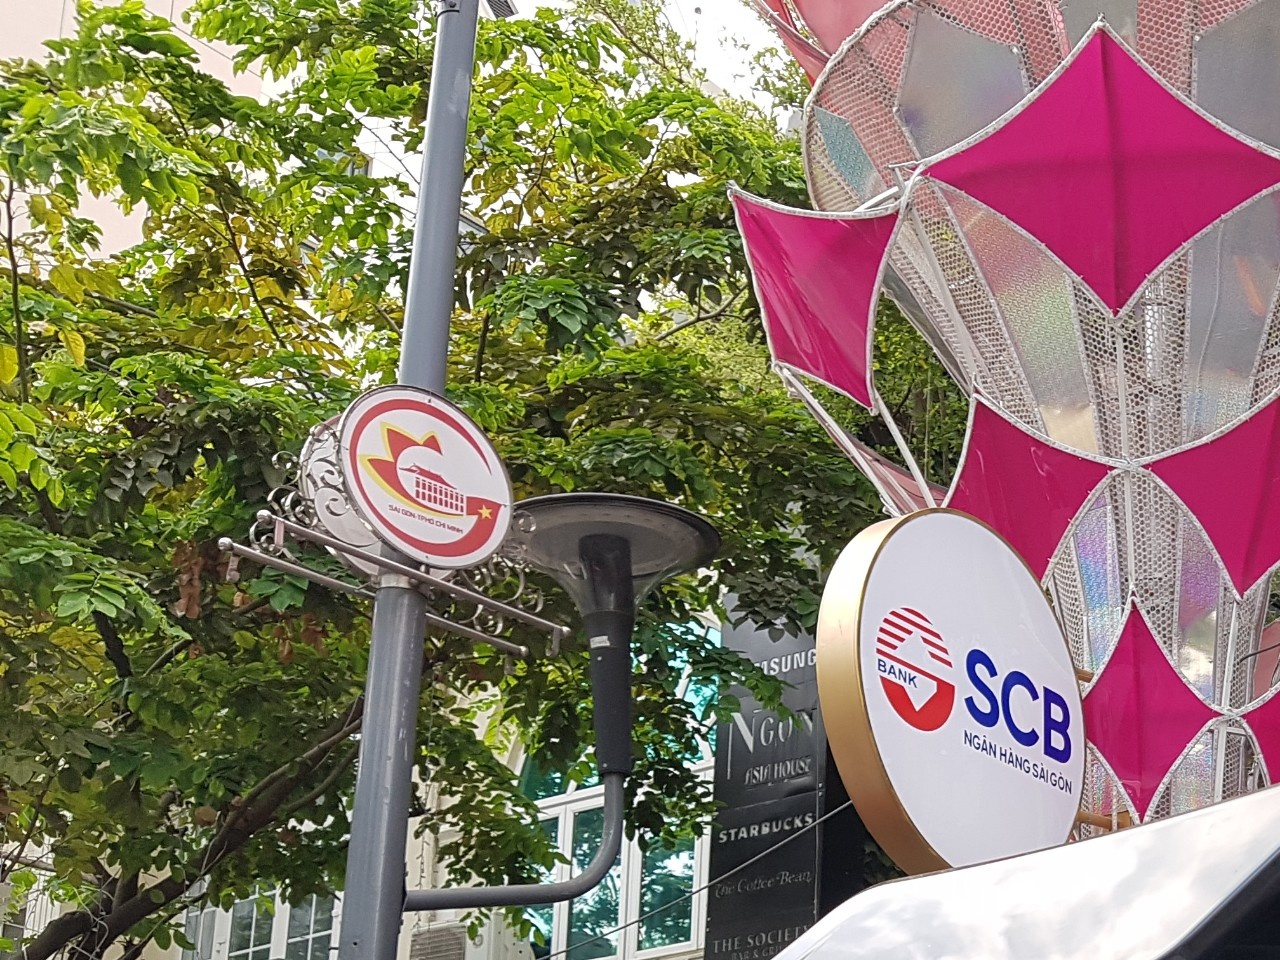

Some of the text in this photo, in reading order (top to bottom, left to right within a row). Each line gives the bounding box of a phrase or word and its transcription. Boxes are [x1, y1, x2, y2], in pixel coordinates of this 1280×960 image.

[877, 658, 918, 689] BANK
[964, 648, 1072, 764] SCB
[964, 729, 1073, 795] NGÂN HÀNG SÀI GÒN
[718, 813, 813, 843] STARBUCKS
[712, 936, 741, 953] THE
